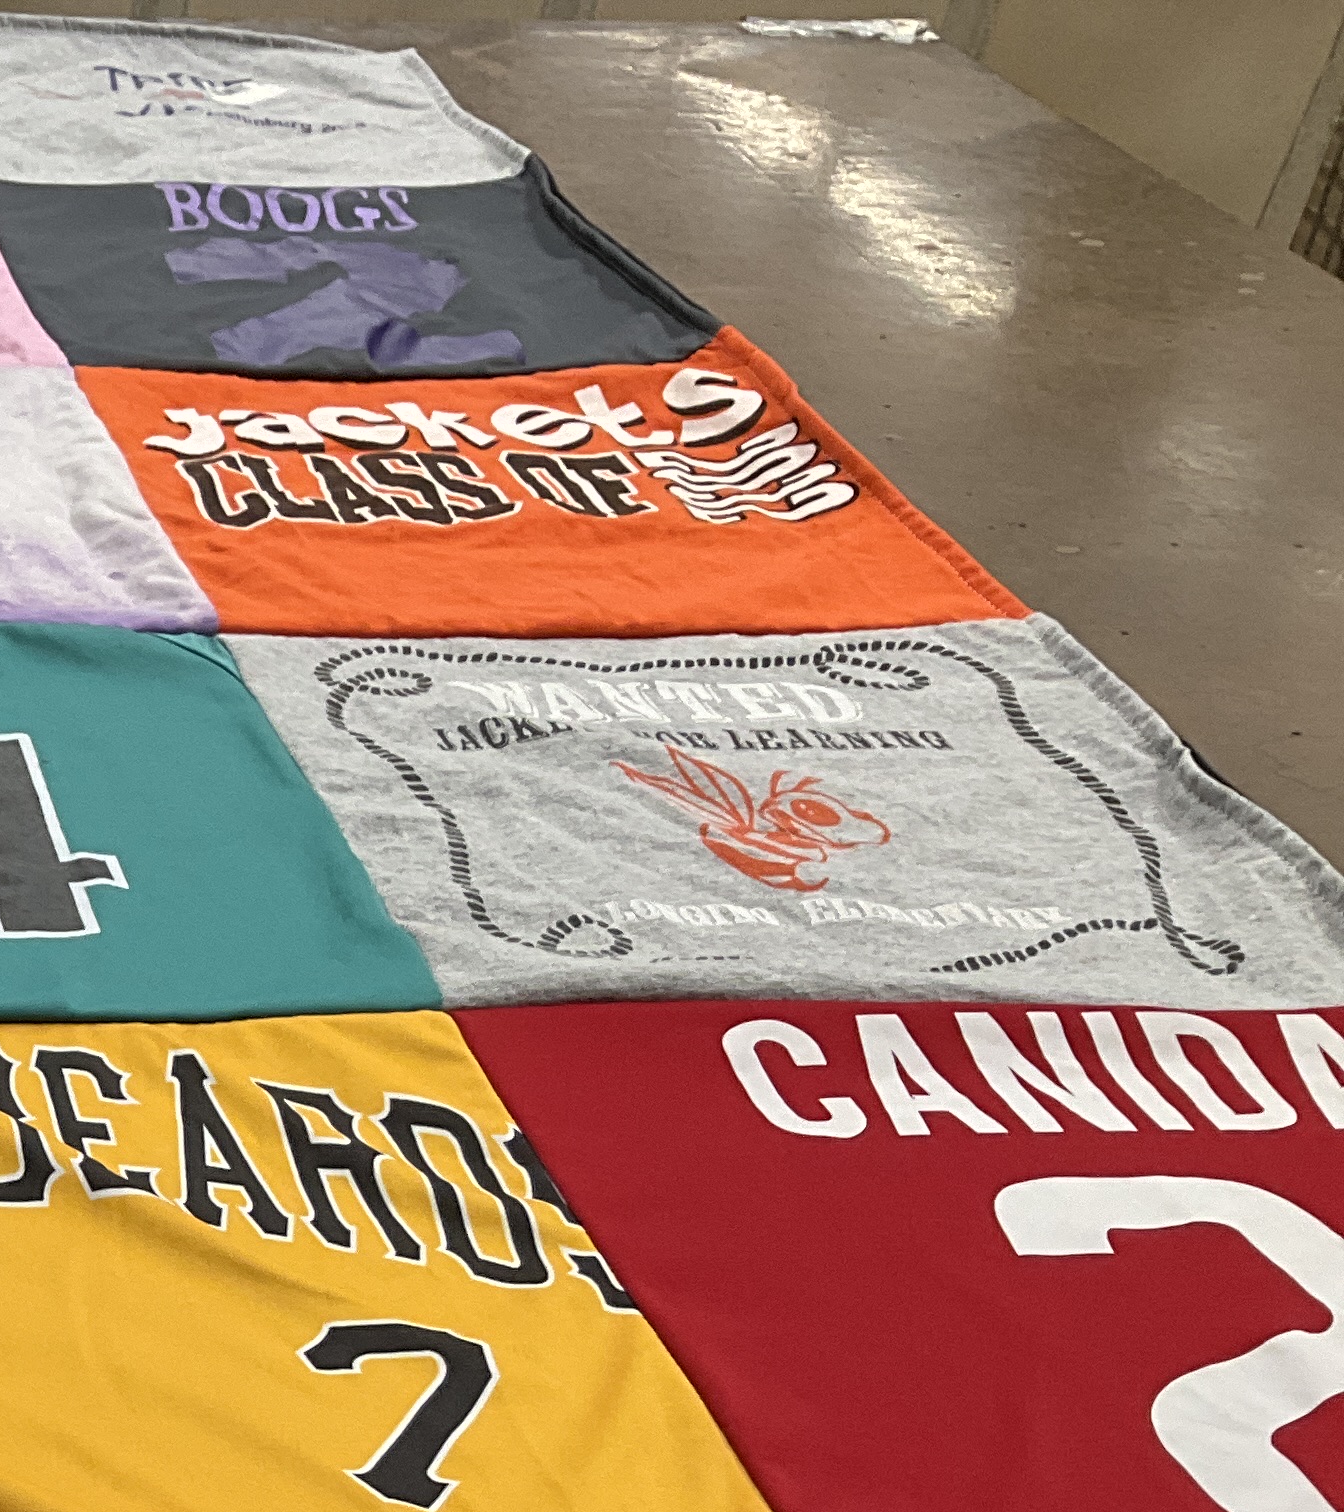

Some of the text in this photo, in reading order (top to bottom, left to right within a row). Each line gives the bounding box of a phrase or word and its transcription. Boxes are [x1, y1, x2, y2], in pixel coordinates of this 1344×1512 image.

[175, 449, 660, 531] CLASS OF
[433, 715, 580, 752] JACKE
[722, 727, 956, 751] LEARNING
[447, 680, 866, 725] WANTED
[296, 1318, 500, 1512] 7
